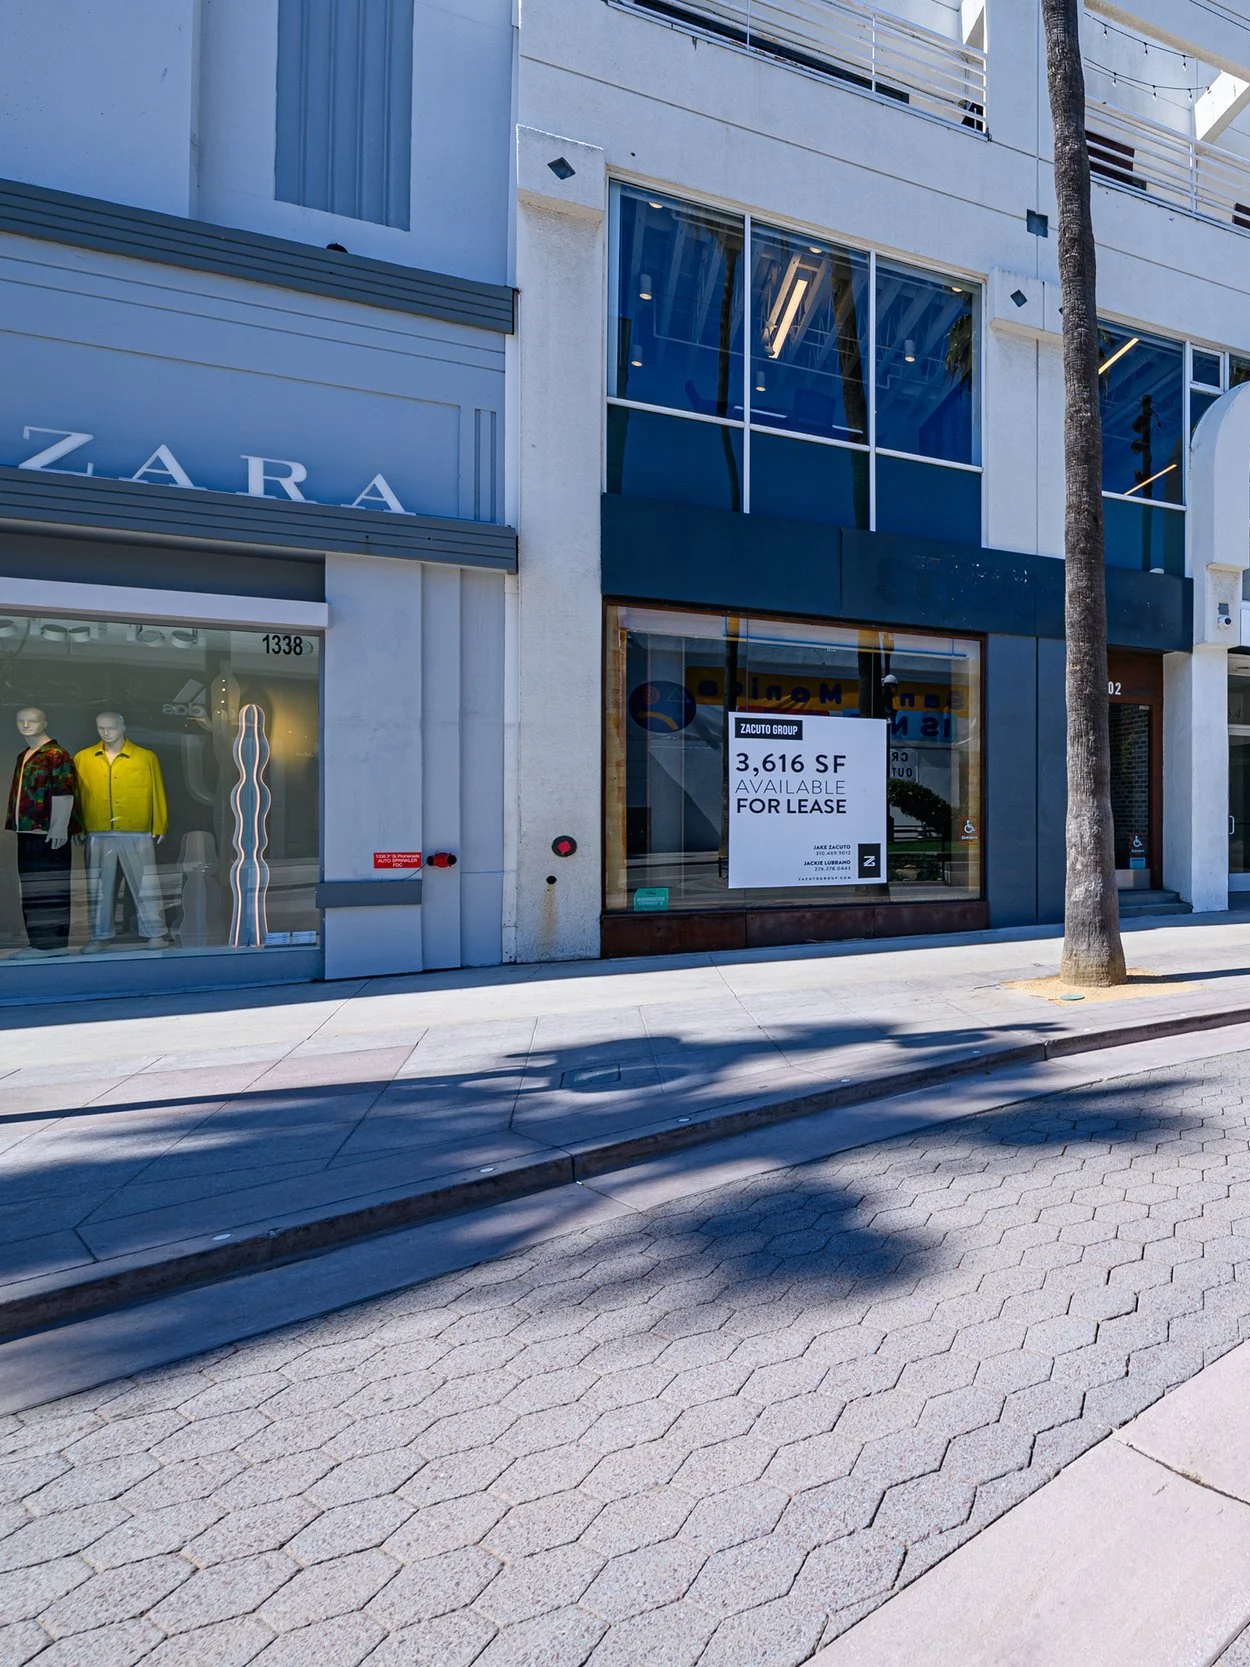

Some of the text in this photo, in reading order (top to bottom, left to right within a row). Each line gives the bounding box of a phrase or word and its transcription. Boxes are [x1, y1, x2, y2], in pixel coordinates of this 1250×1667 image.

[18, 425, 417, 516] ZARA
[262, 634, 303, 656] 1338
[1108, 680, 1122, 696] 02
[740, 723, 798, 736] ZACUTO GROUP
[735, 752, 847, 777] 3,616 SF
[734, 779, 846, 795] AVAILABLE
[736, 798, 847, 814] FOR LEASE
